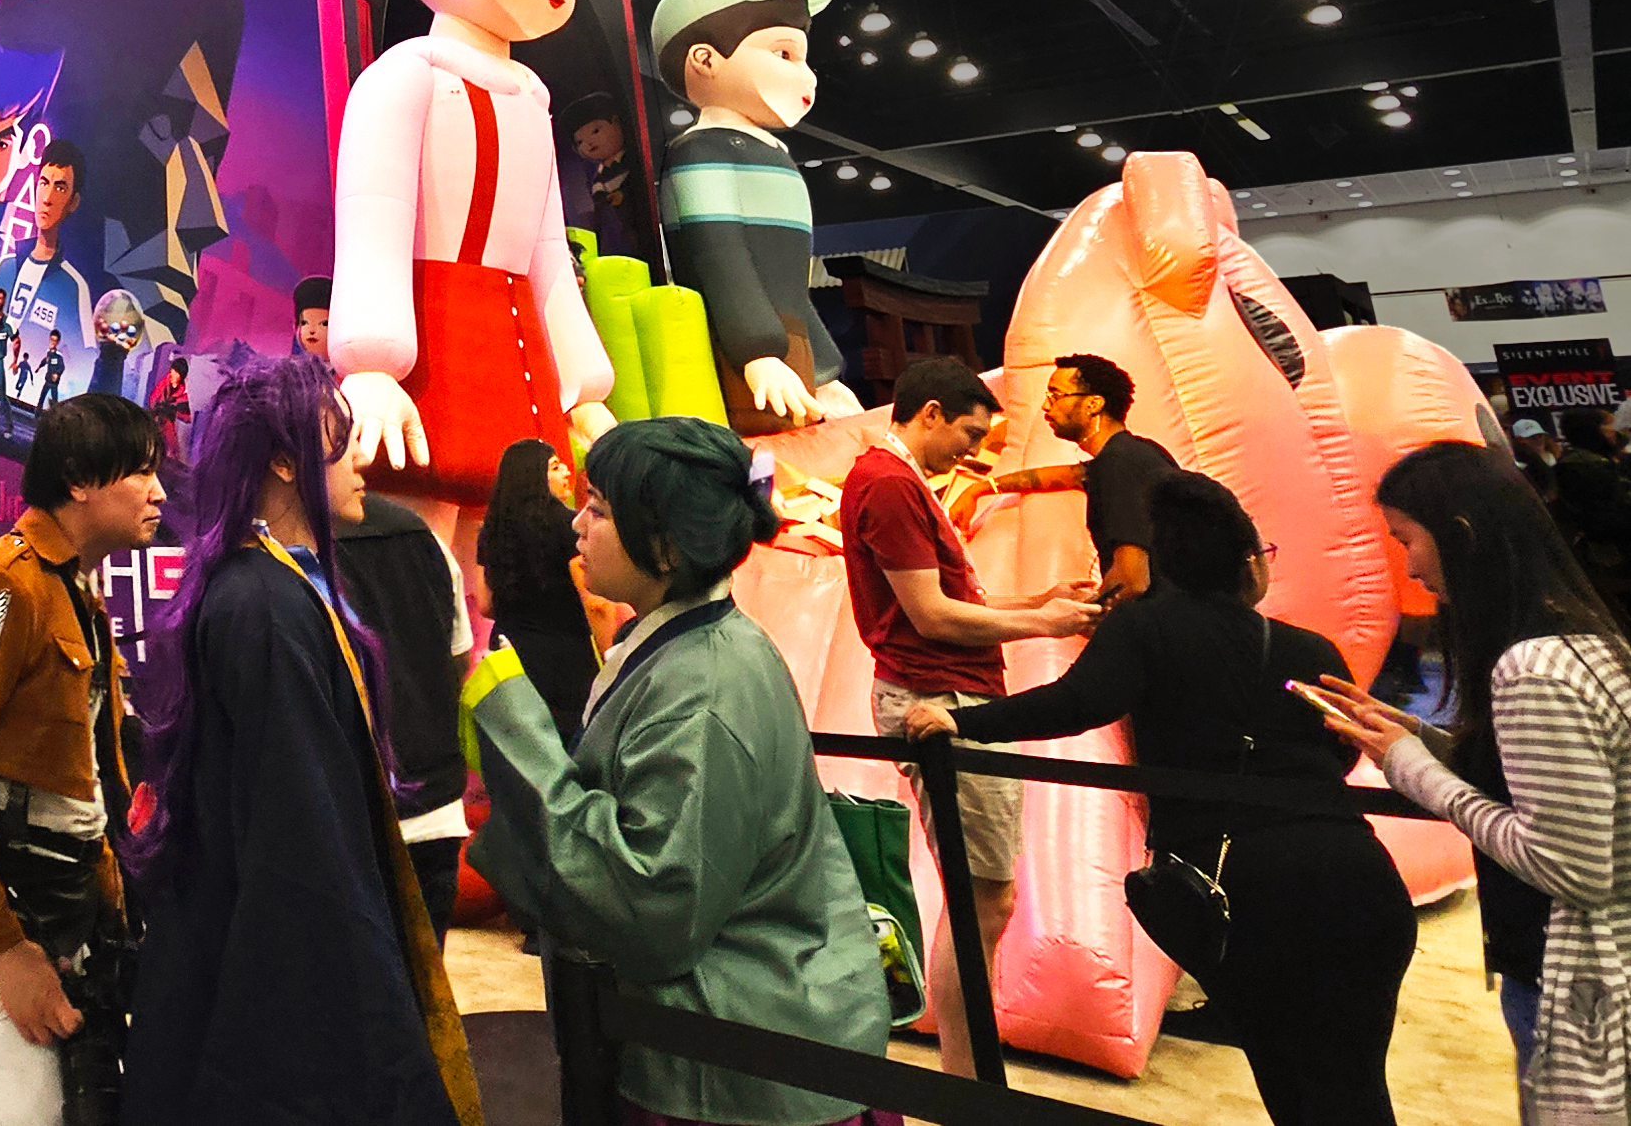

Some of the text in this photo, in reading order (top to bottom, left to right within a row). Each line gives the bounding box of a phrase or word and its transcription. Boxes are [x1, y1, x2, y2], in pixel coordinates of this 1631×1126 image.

[33, 305, 55, 323] 456
[1502, 347, 1591, 361] SILENT HILL
[1508, 371, 1615, 386] EVENT
[1511, 383, 1622, 408] EXCLUSIVE
